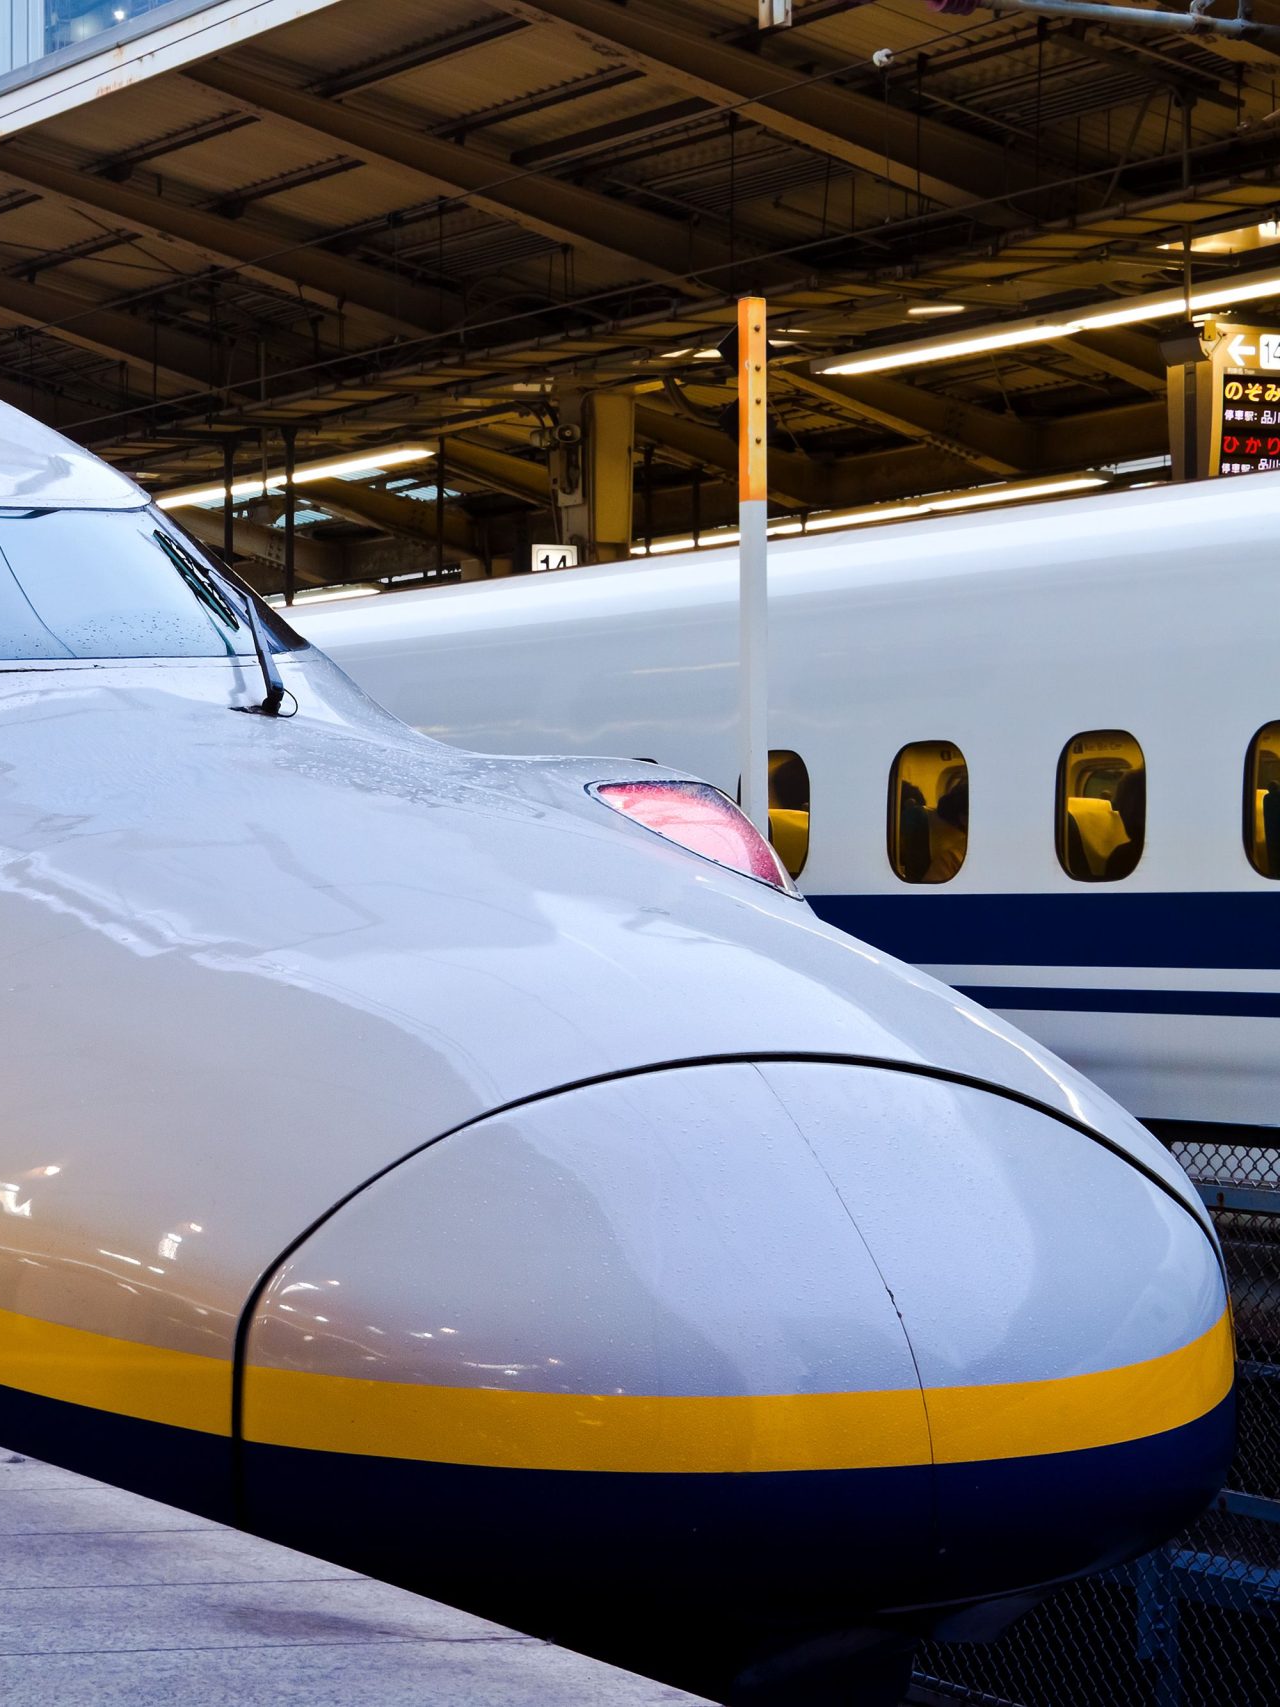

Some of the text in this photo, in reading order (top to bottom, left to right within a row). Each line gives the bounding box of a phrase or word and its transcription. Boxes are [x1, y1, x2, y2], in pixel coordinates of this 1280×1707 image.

[1225, 381, 1280, 402] のぞみ
[1223, 436, 1280, 455] ひかり
[540, 554, 567, 570] 14
